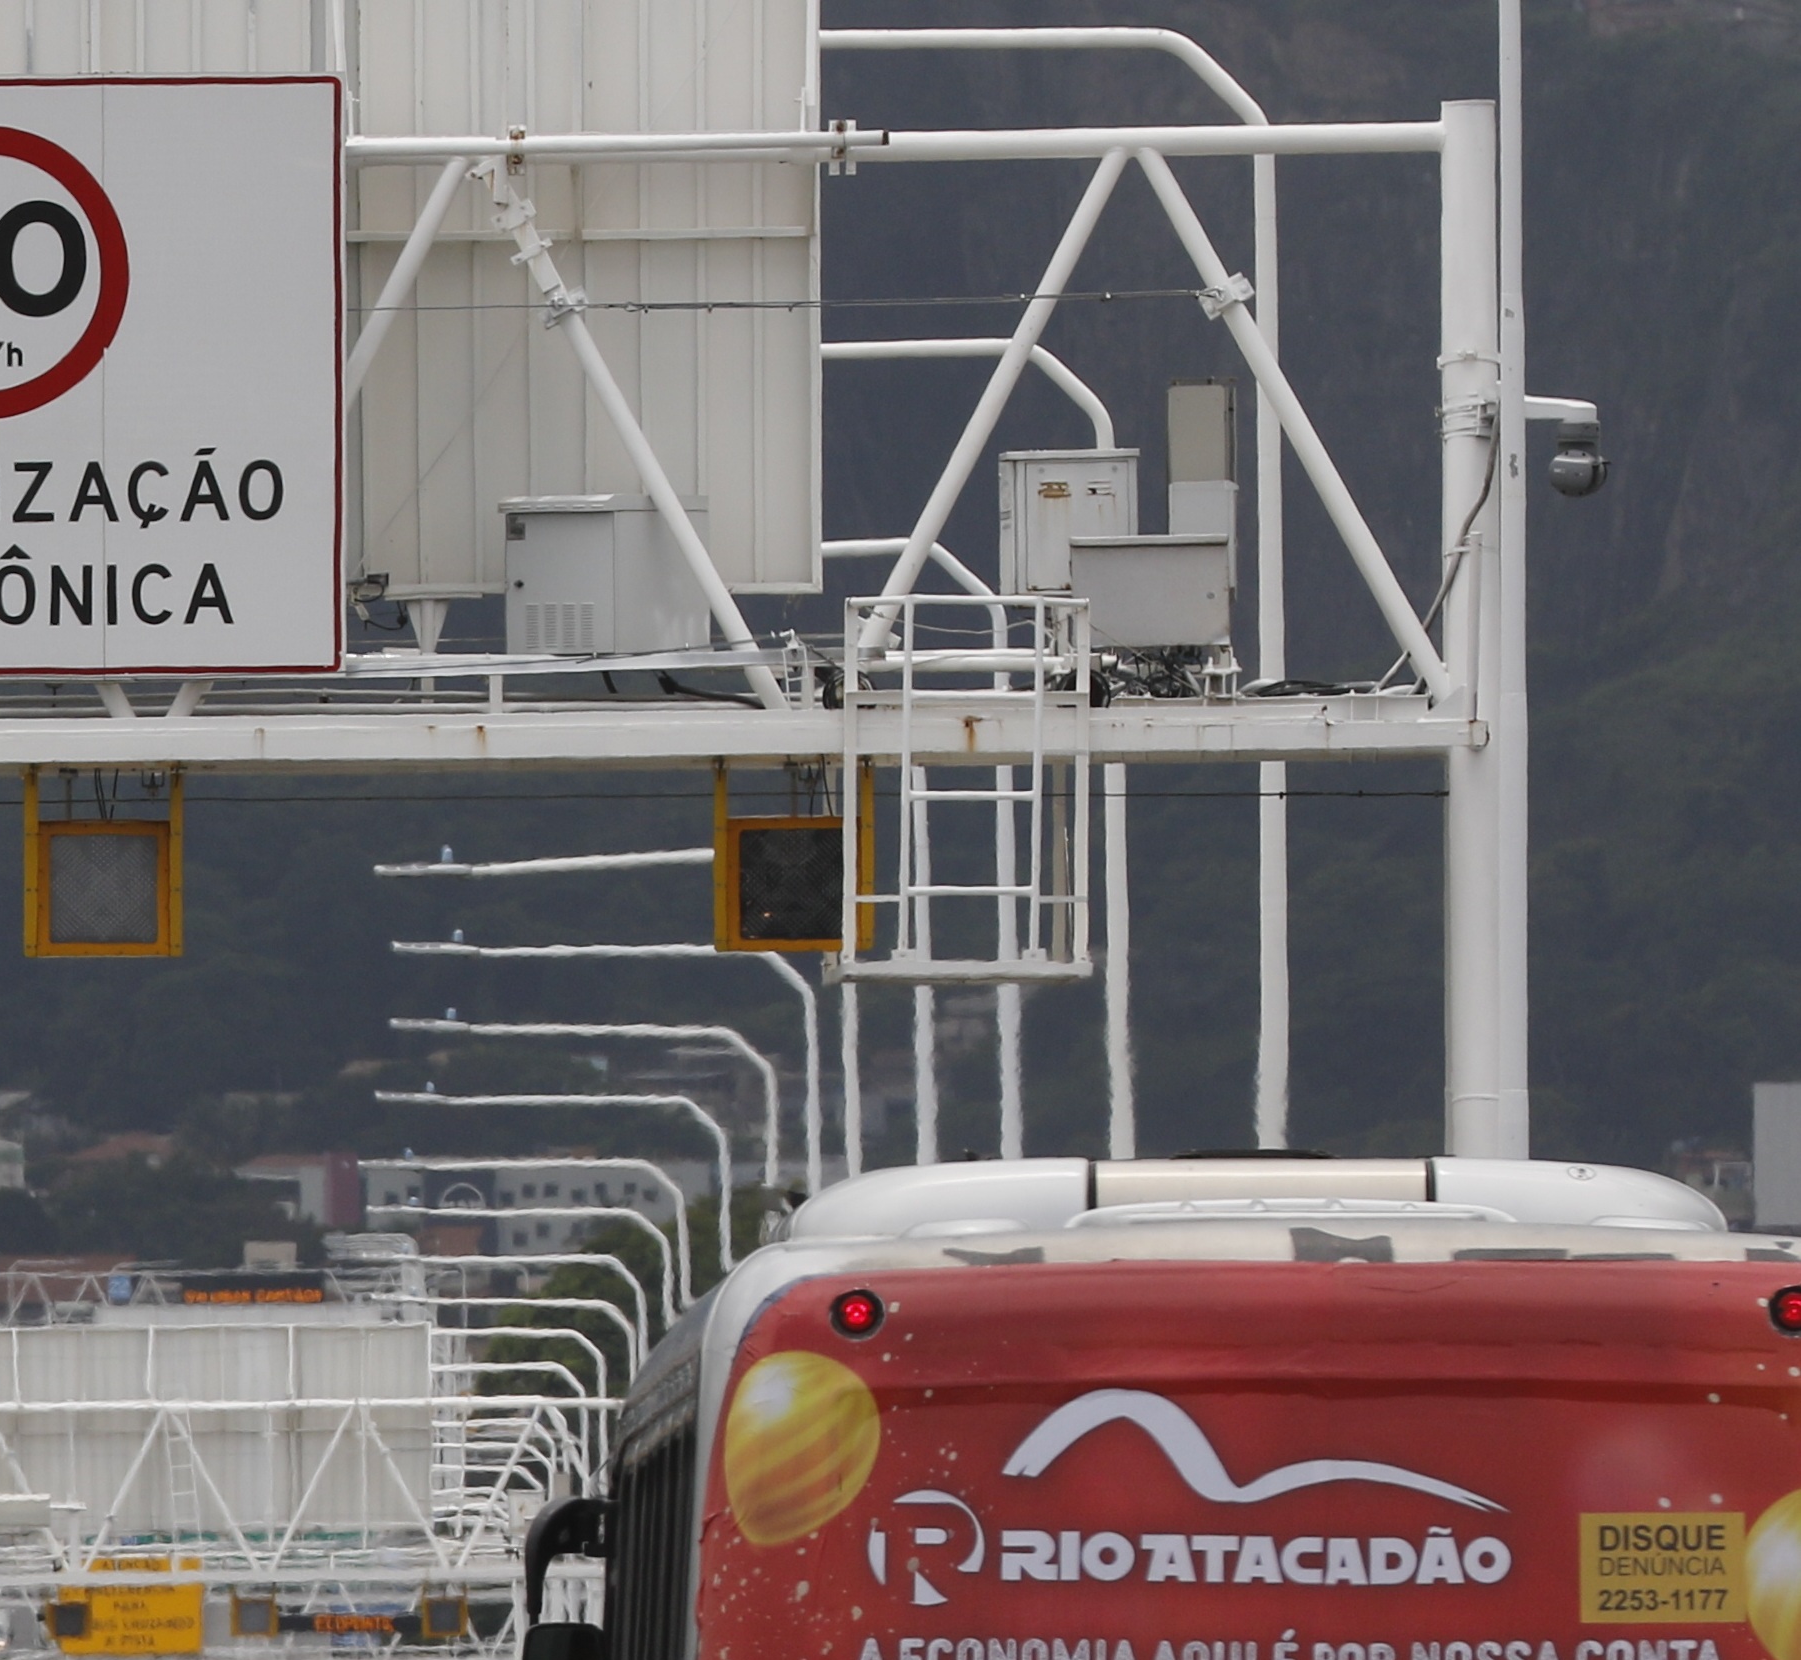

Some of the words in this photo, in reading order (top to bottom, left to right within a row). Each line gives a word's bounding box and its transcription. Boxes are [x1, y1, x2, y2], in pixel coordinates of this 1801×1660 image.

[1599, 1525, 1725, 1552] DISQUE
[1001, 1530, 1135, 1582] RIO
[1141, 1526, 1512, 1585] ATACADÃO
[1599, 1553, 1725, 1577] DENÚNCIA
[1598, 1589, 1728, 1611] 2253-1177
